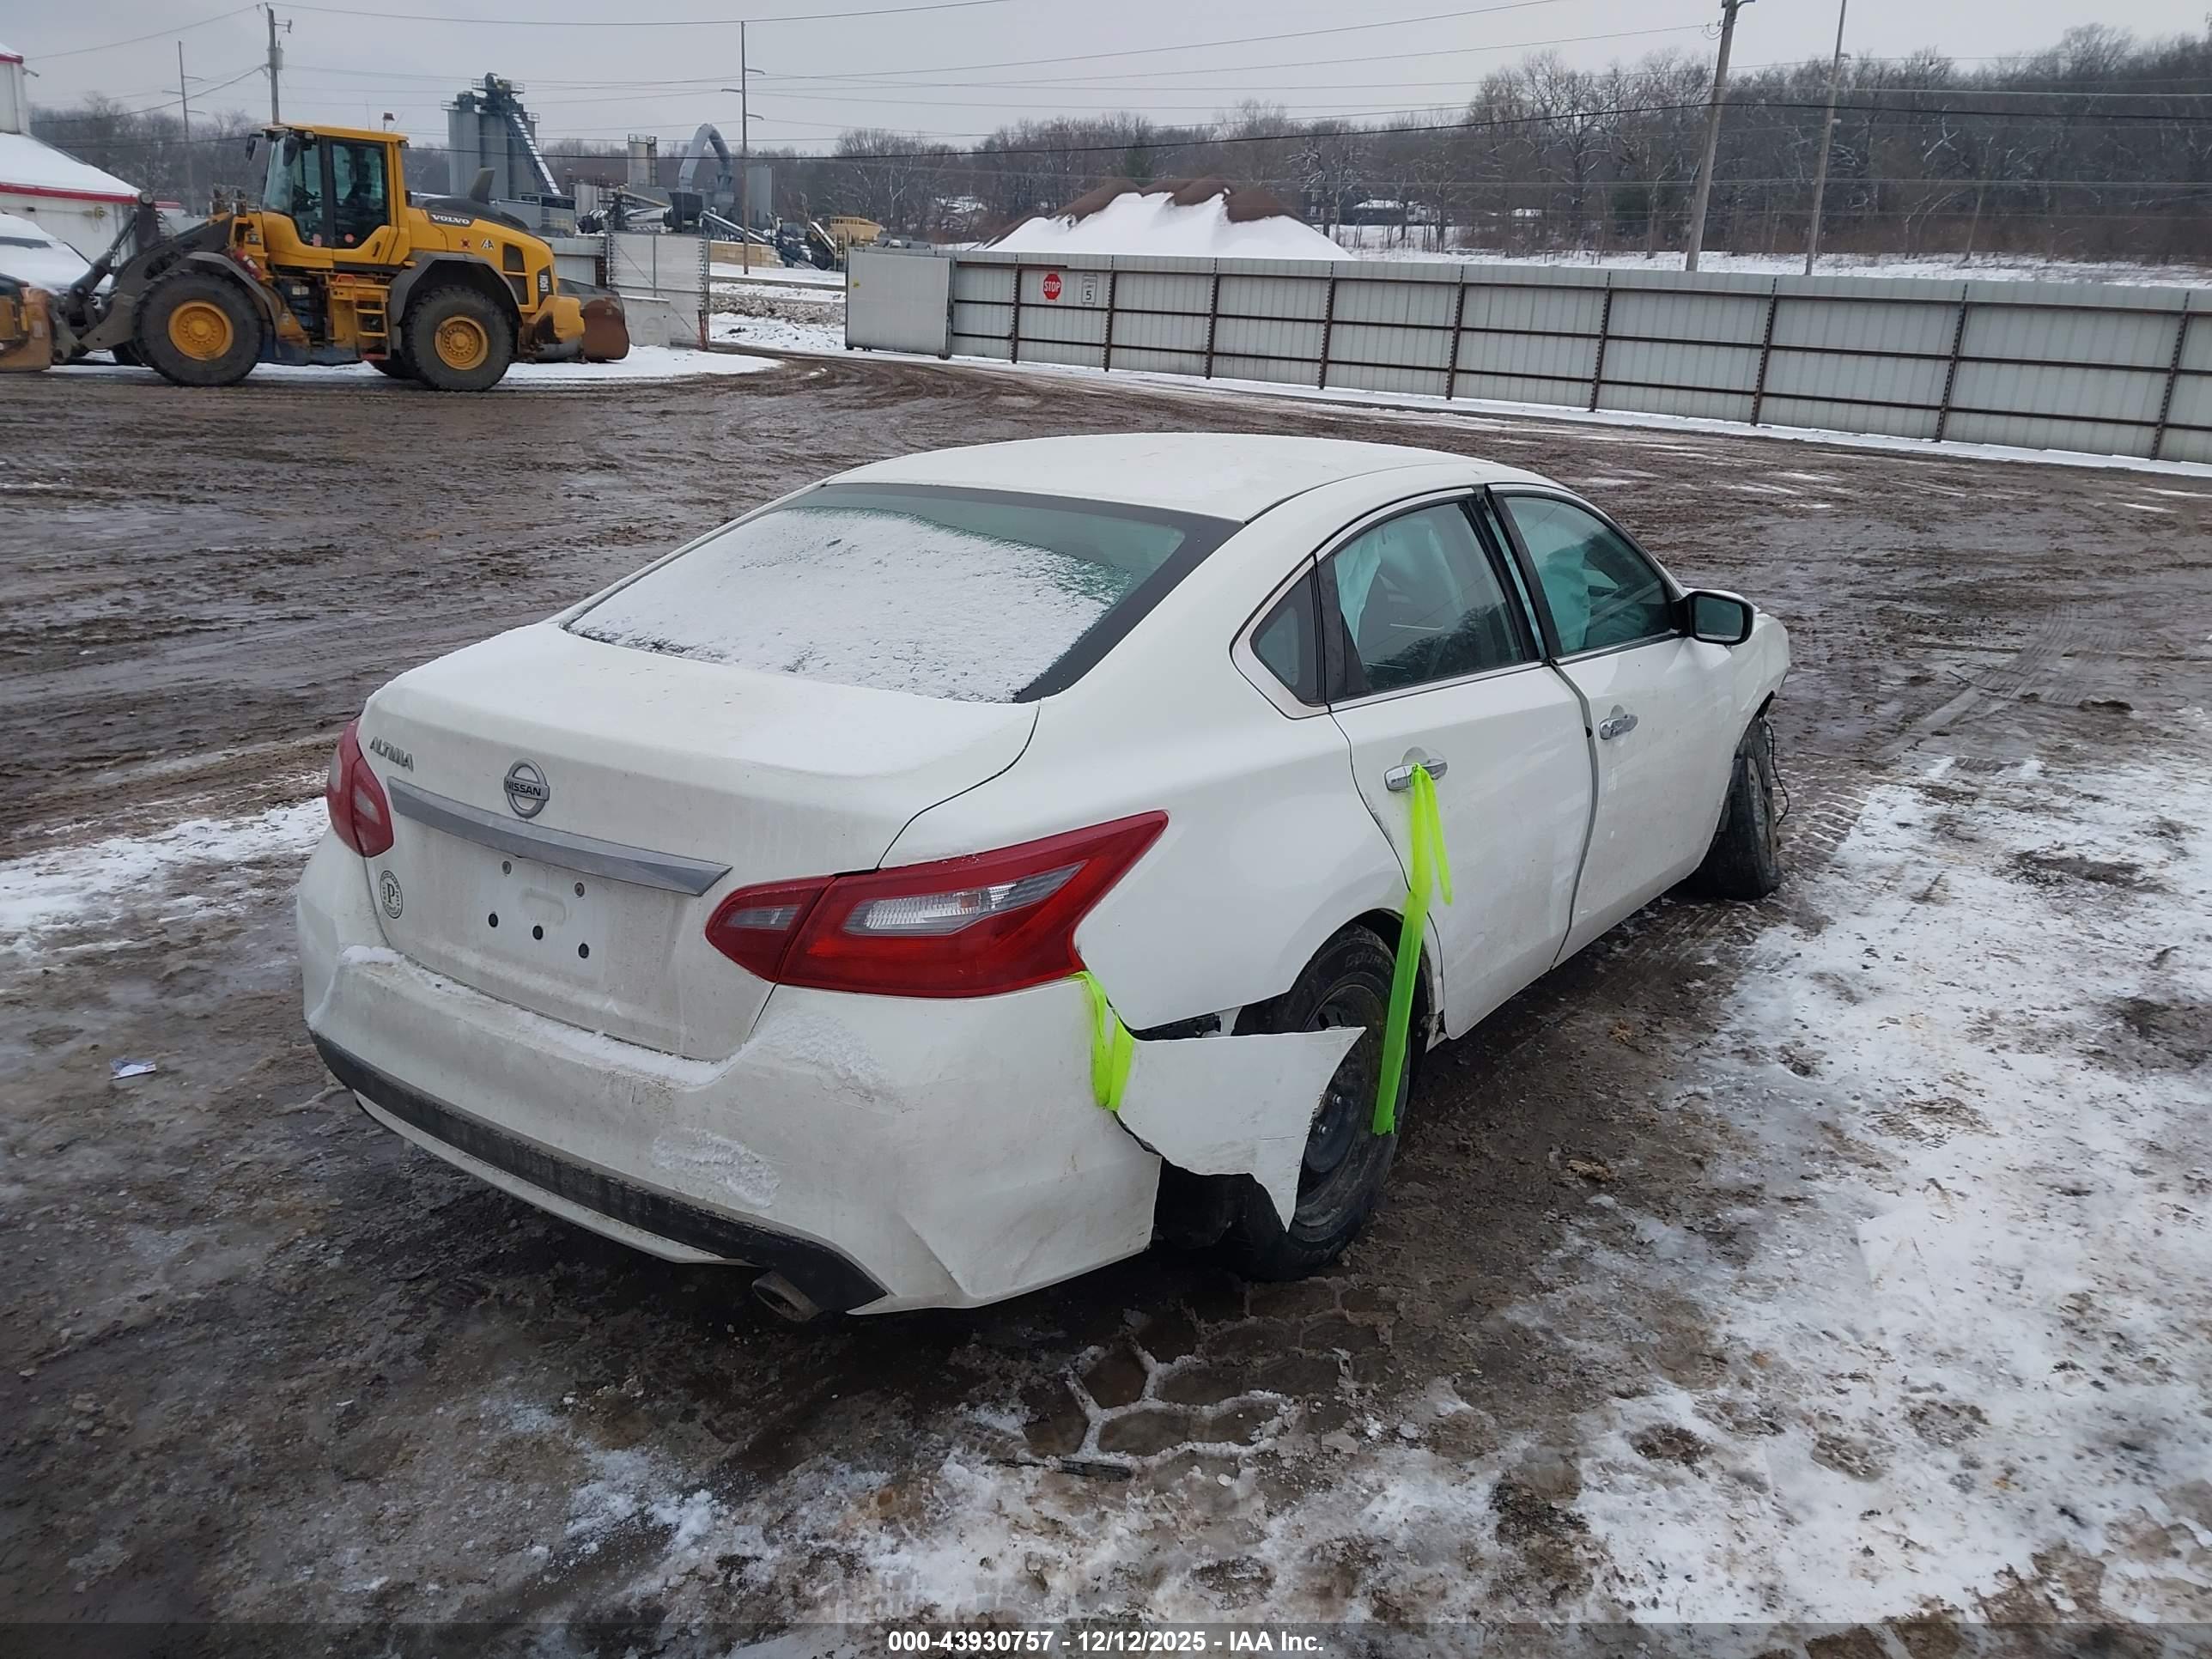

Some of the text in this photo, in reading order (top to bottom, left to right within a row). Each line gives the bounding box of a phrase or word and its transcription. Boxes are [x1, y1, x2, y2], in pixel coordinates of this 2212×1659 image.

[430, 214, 470, 225] VOLVO
[1043, 281, 1061, 292] STOP
[1085, 290, 1092, 300] 5
[507, 781, 542, 797] NISSAN
